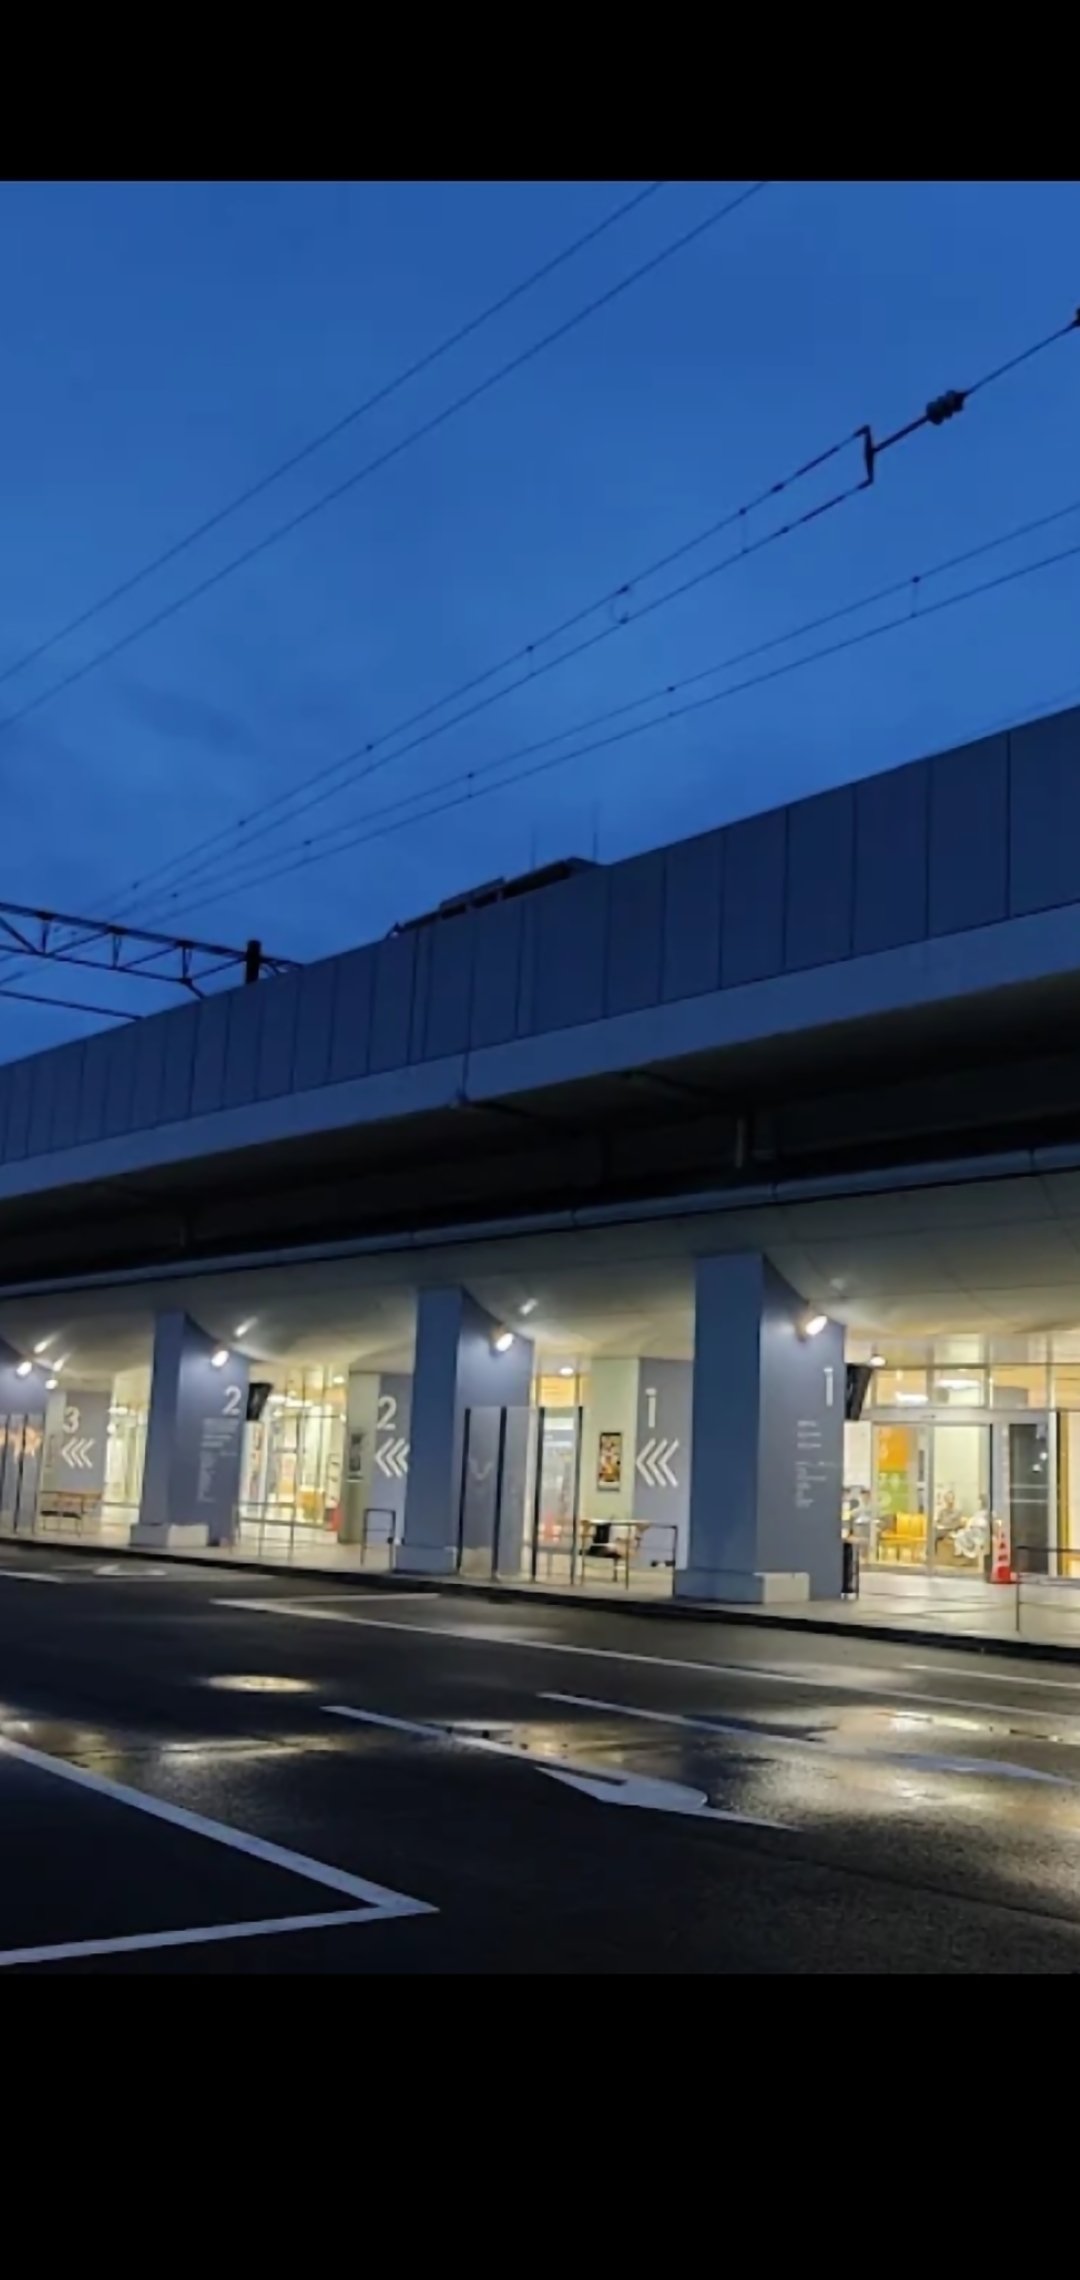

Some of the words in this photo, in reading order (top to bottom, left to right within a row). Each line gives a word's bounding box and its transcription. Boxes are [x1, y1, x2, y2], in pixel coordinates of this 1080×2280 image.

[222, 1386, 241, 1415] 2
[377, 1396, 396, 1430] 2
[62, 1406, 80, 1434] 3
